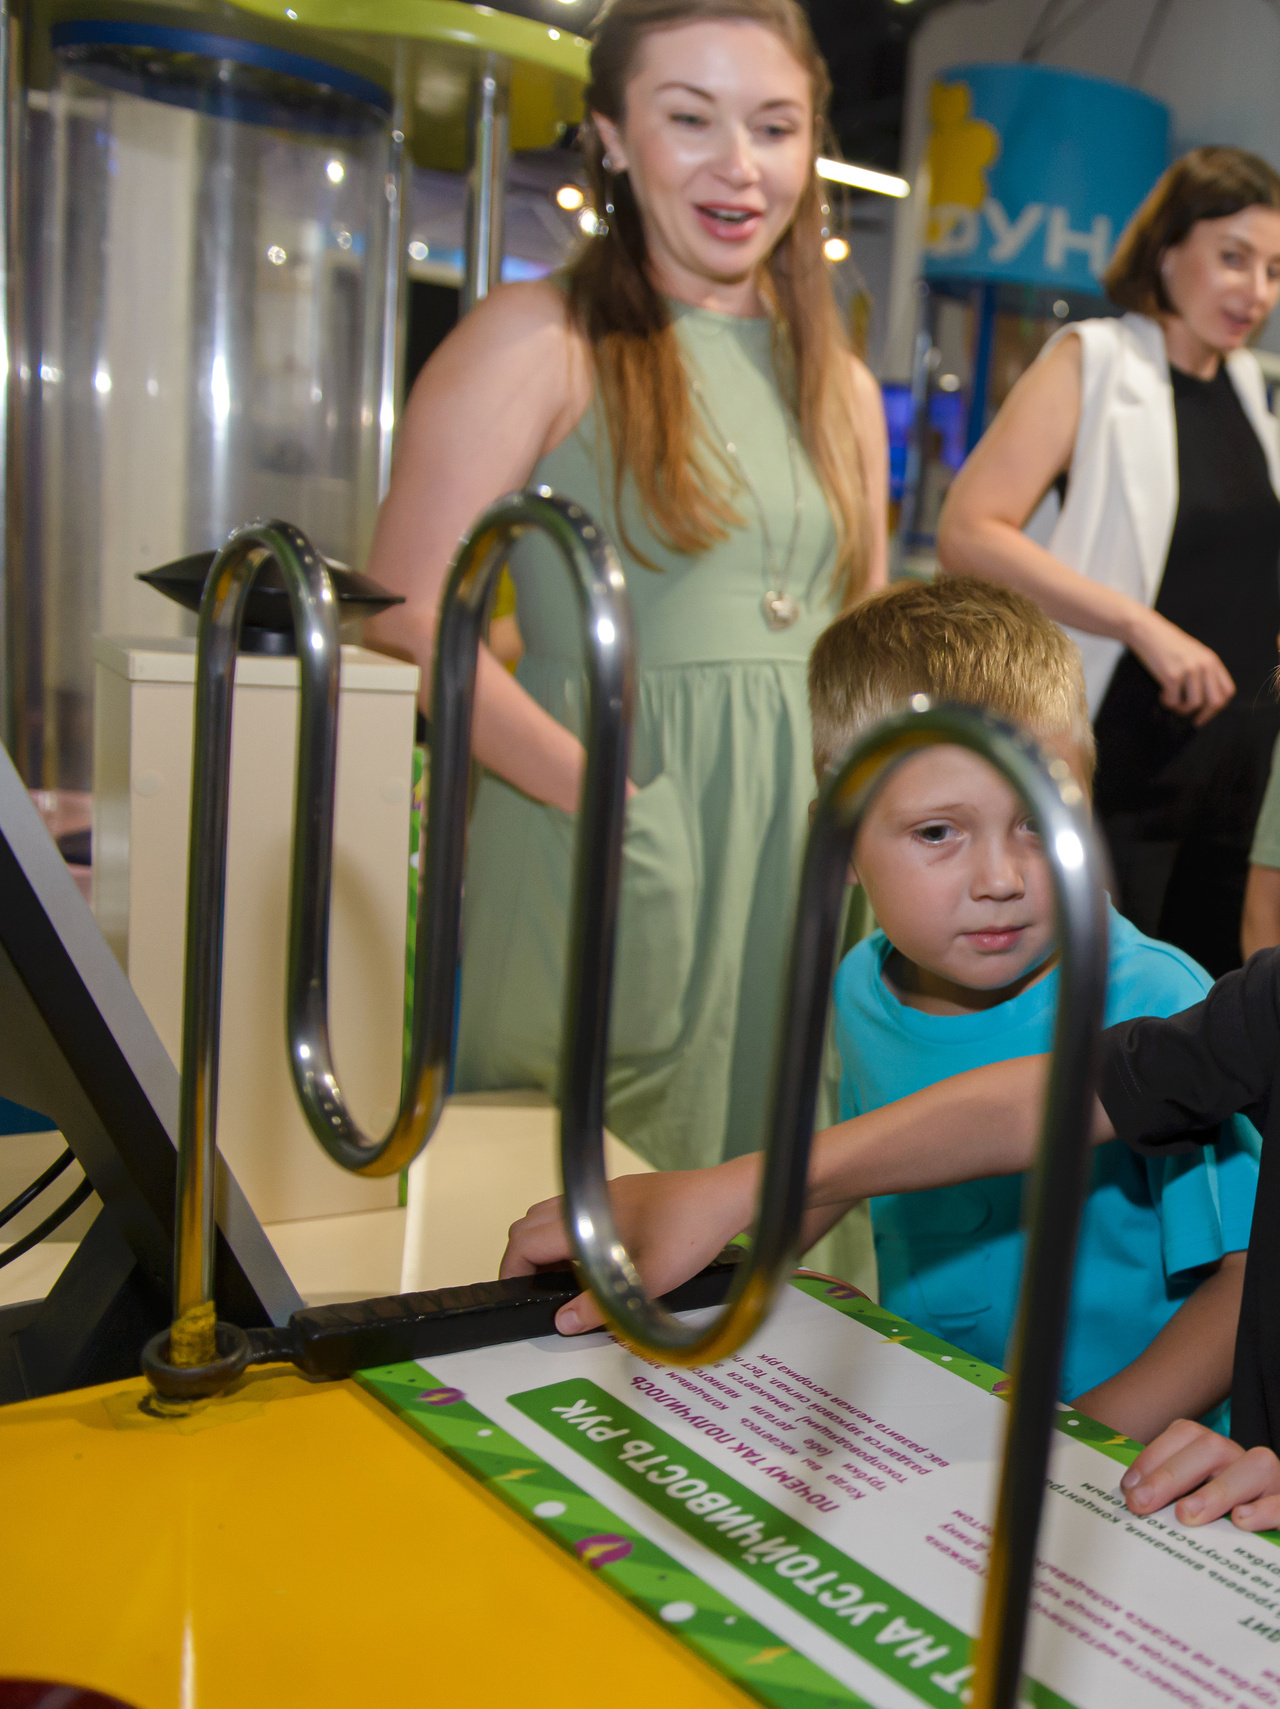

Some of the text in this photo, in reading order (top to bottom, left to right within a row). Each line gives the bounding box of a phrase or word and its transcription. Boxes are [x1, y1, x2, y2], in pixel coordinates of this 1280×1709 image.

[665, 1370, 728, 1411] кольцевым
[756, 1352, 949, 1468] вас развита мелкая моторика рук
[550, 1397, 629, 1446] РУК
[726, 1370, 907, 1484] токопроводящим) замыкается
[739, 1416, 798, 1456] касаетесь
[741, 1363, 931, 1476] раздается звуковой сигнал. Тест
[750, 1403, 796, 1432] детали
[628, 1373, 839, 1513] ПОЧЕМУ ТАК ПОЛУЧИЛОСЬ
[800, 1457, 822, 1471] вы
[825, 1472, 865, 1501] Когда
[841, 1461, 886, 1491] трубки
[616, 1439, 889, 1626] УСТОЙЧИВОСТЬ
[937, 1522, 988, 1551] длину
[1121, 1523, 1205, 1570] внимания,
[1166, 1529, 1249, 1576] коснуться
[1207, 1569, 1278, 1609] уровень
[1249, 1574, 1274, 1588] не
[873, 1615, 950, 1668] НА
